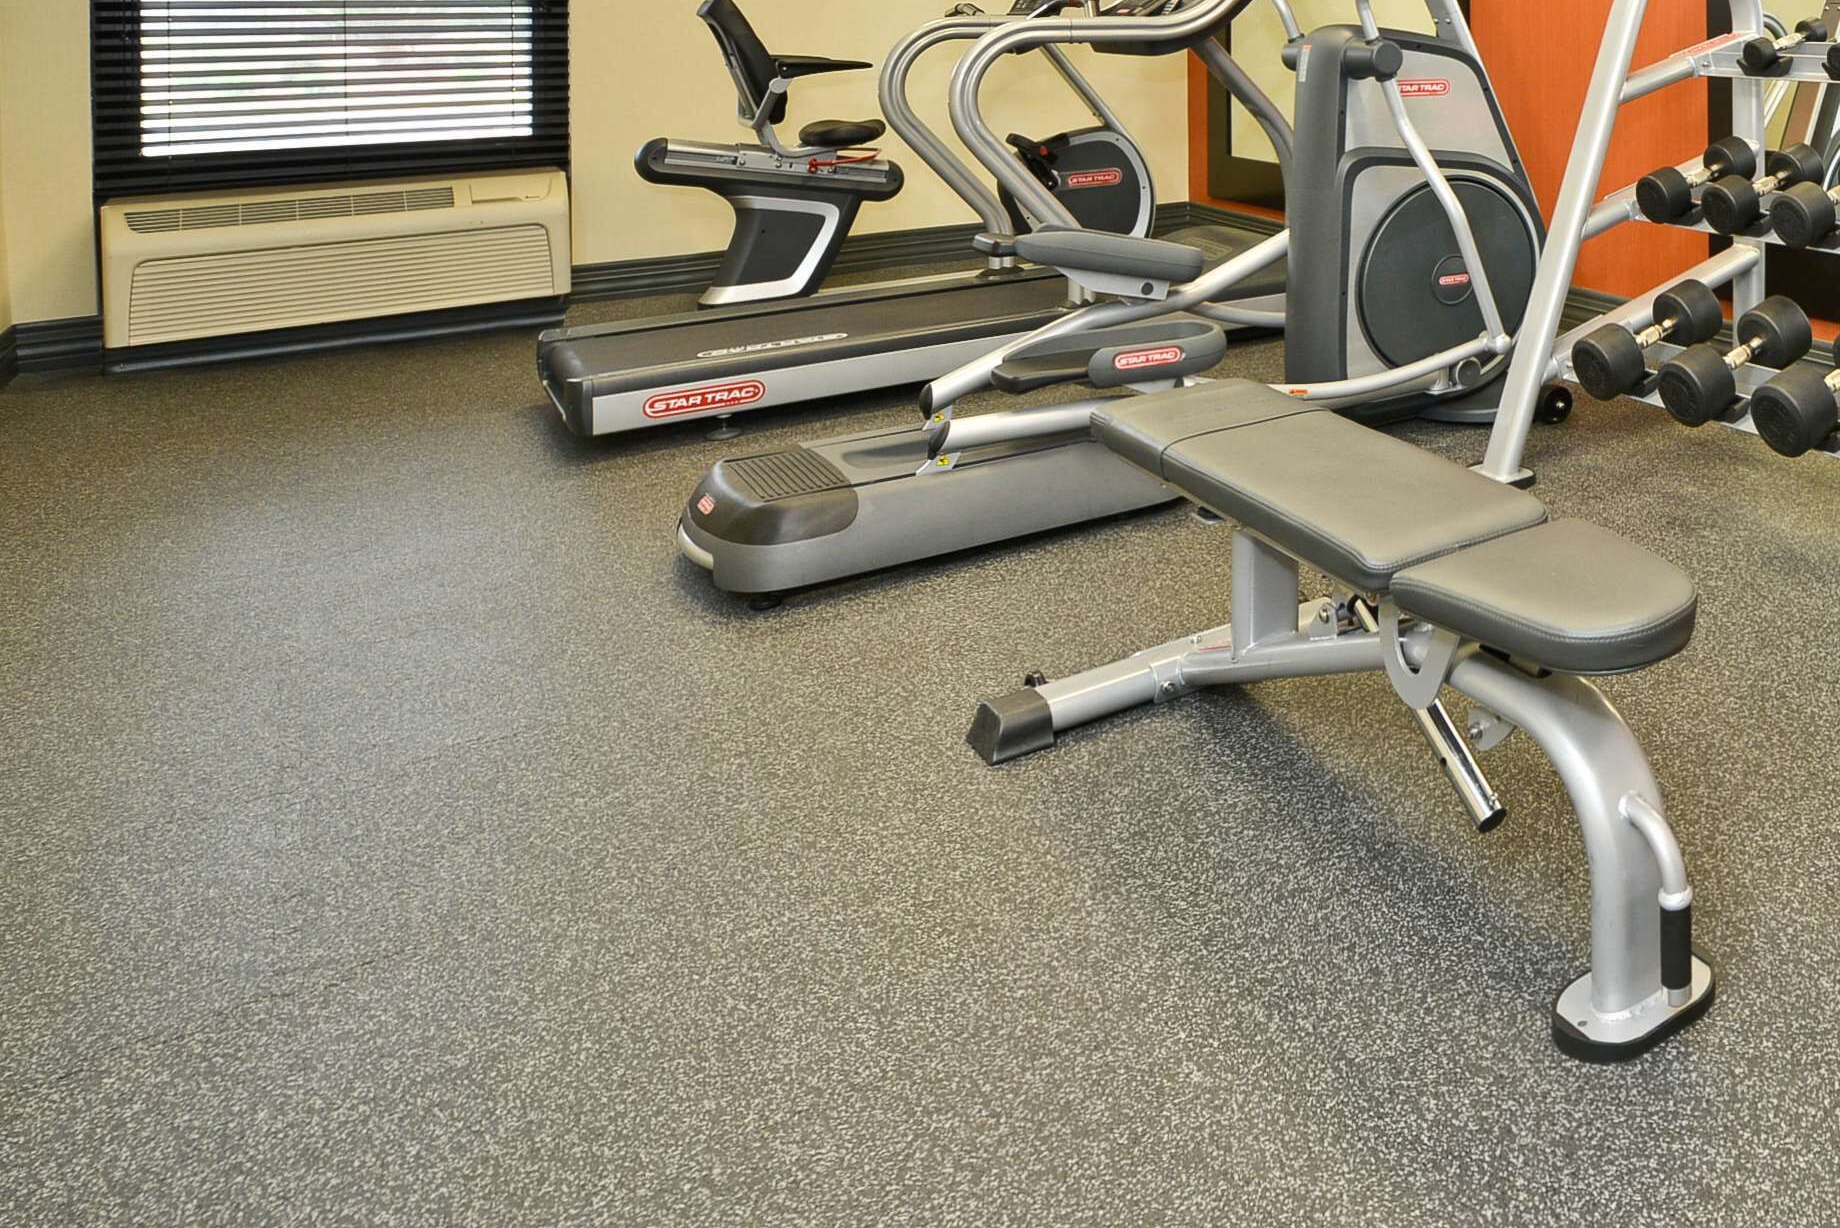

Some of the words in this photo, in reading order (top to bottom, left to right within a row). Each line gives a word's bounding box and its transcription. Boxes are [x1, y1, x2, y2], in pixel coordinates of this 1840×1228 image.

[1399, 83, 1418, 92] TAR
[1419, 83, 1445, 92] TRAC
[1119, 355, 1147, 365] STAR
[1147, 351, 1176, 361] TRAC
[653, 395, 702, 411] STAR
[704, 387, 755, 403] TRAC
